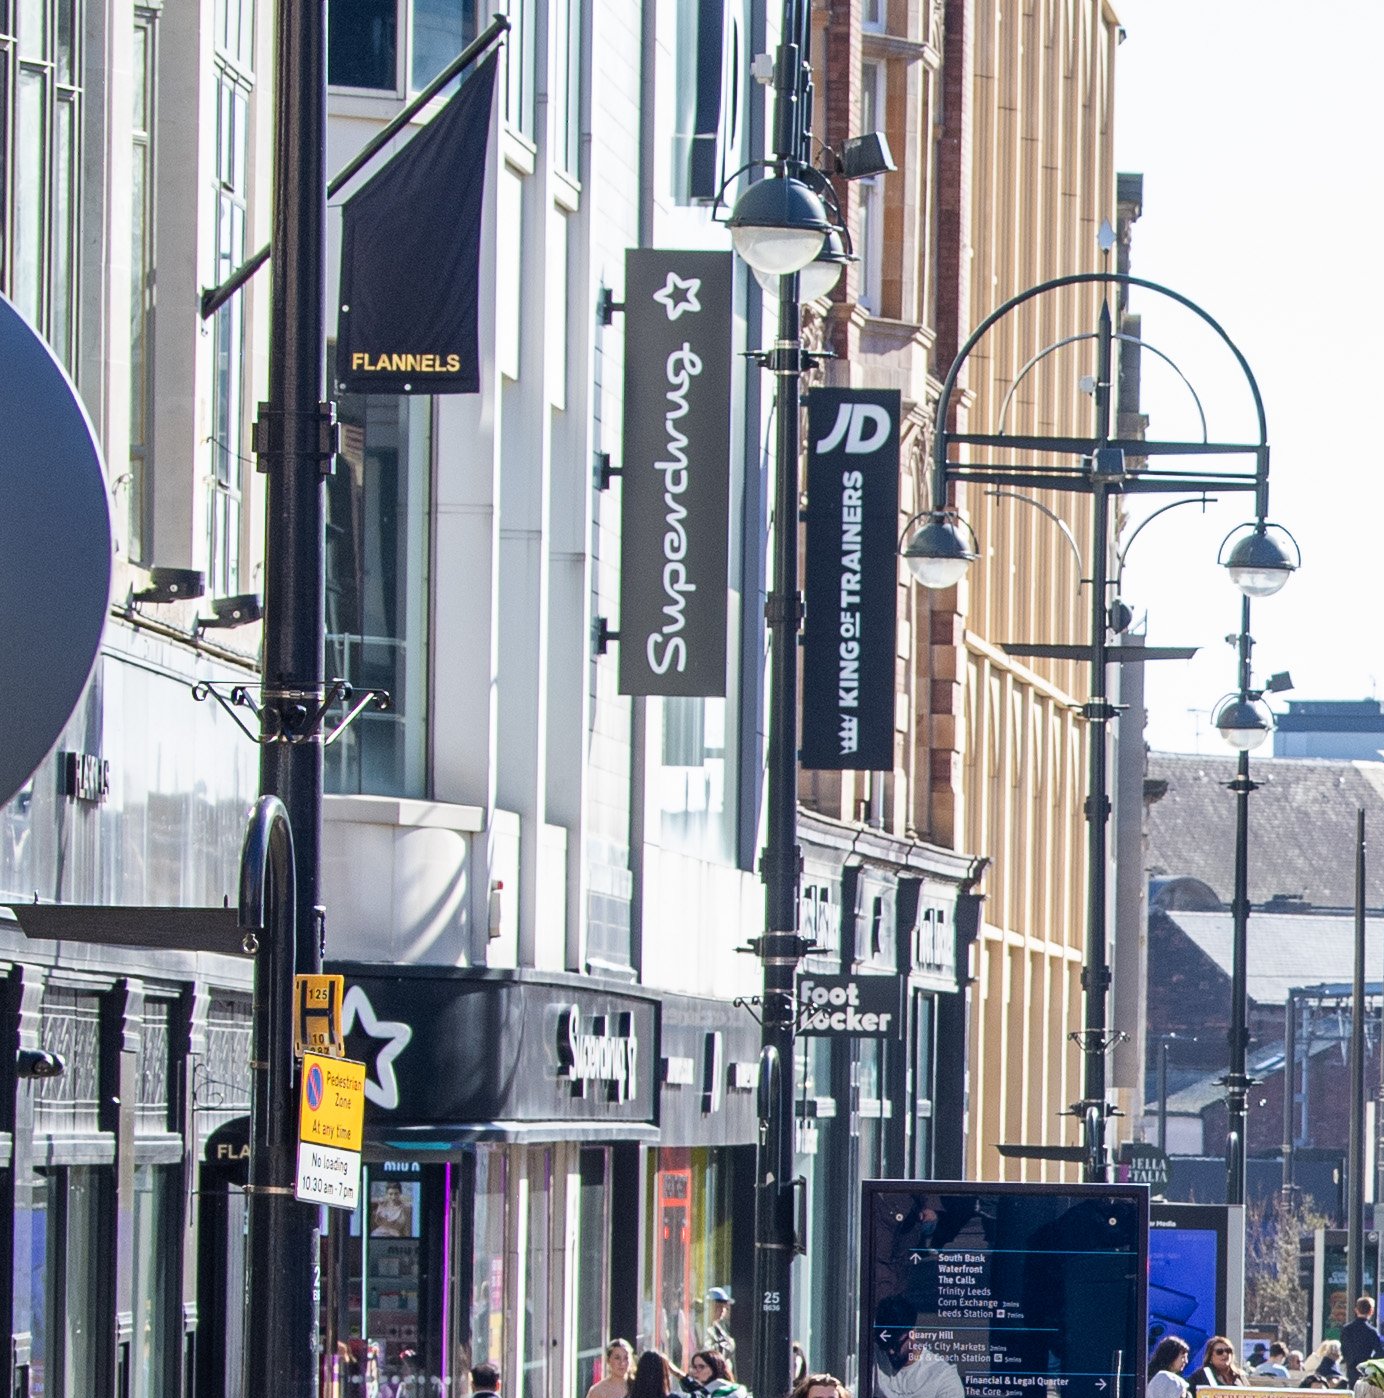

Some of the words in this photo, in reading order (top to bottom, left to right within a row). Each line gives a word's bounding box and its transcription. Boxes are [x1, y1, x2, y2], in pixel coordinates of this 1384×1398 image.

[352, 353, 460, 371] FLANNELS
[816, 403, 892, 454] JD
[647, 342, 702, 675] Superdrug
[839, 470, 863, 609] TRAINERS
[840, 611, 860, 638] OF
[839, 641, 859, 707] KING
[309, 987, 328, 999] 125
[312, 1033, 325, 1043] 10
[326, 1070, 362, 1092] Pedestrian
[335, 1092, 352, 1110] Zone
[312, 1119, 325, 1133] At
[325, 1122, 335, 1140] any
[335, 1125, 352, 1141] time
[312, 1152, 323, 1168] No
[323, 1154, 348, 1175] loading
[938, 1253, 963, 1263] South
[965, 1254, 986, 1263] Bank
[938, 1264, 983, 1273] Waterfront
[938, 1275, 954, 1284] The
[955, 1275, 976, 1284] Calls
[763, 1291, 780, 1304] 25
[938, 1287, 965, 1297] Trinity
[967, 1287, 991, 1296] Leeds
[938, 1298, 957, 1307] Corn
[959, 1299, 998, 1309] Exchange
[938, 1309, 962, 1318] Leeds
[963, 1309, 994, 1319] Station
[908, 1331, 936, 1341] Quarry
[938, 1331, 954, 1340] Hill
[908, 1342, 932, 1351] Leeds
[934, 1342, 950, 1352] City
[953, 1342, 986, 1351] Markets
[908, 1353, 923, 1362] Bus
[934, 1353, 960, 1362] Coach
[962, 1354, 991, 1362] Station
[965, 1376, 1002, 1385] Financial
[1004, 1377, 1011, 1385] &
[1013, 1377, 1035, 1387] Legal
[1037, 1378, 1069, 1387] Quarter
[965, 1387, 980, 1396] The
[982, 1387, 1001, 1396] Core
